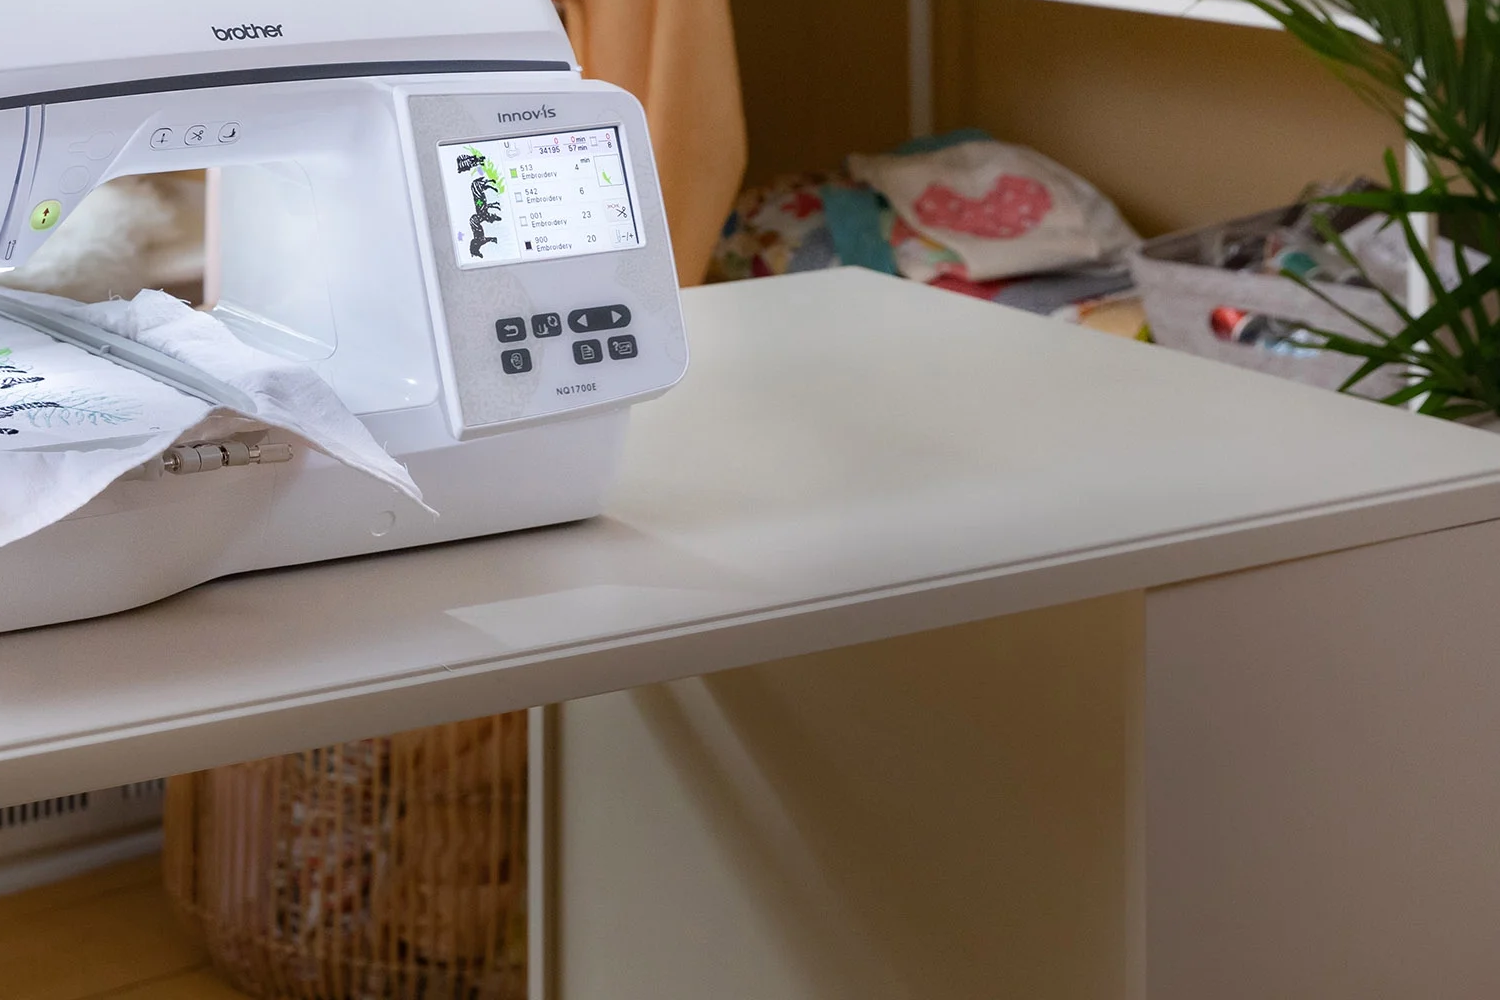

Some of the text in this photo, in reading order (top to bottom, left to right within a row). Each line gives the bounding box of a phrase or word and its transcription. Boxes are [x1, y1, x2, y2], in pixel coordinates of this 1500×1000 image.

[211, 23, 284, 42] brother
[539, 146, 561, 155] 34195
[520, 164, 533, 172] 513
[521, 171, 557, 180] Embroidery
[526, 195, 562, 204] Embroidery
[530, 212, 542, 220] 001
[582, 210, 592, 219] 23
[531, 219, 568, 228] Embroidery
[535, 235, 548, 244] 900
[586, 234, 597, 243] 20
[537, 243, 573, 252] Embroidery
[556, 382, 597, 395] NQ1700E
